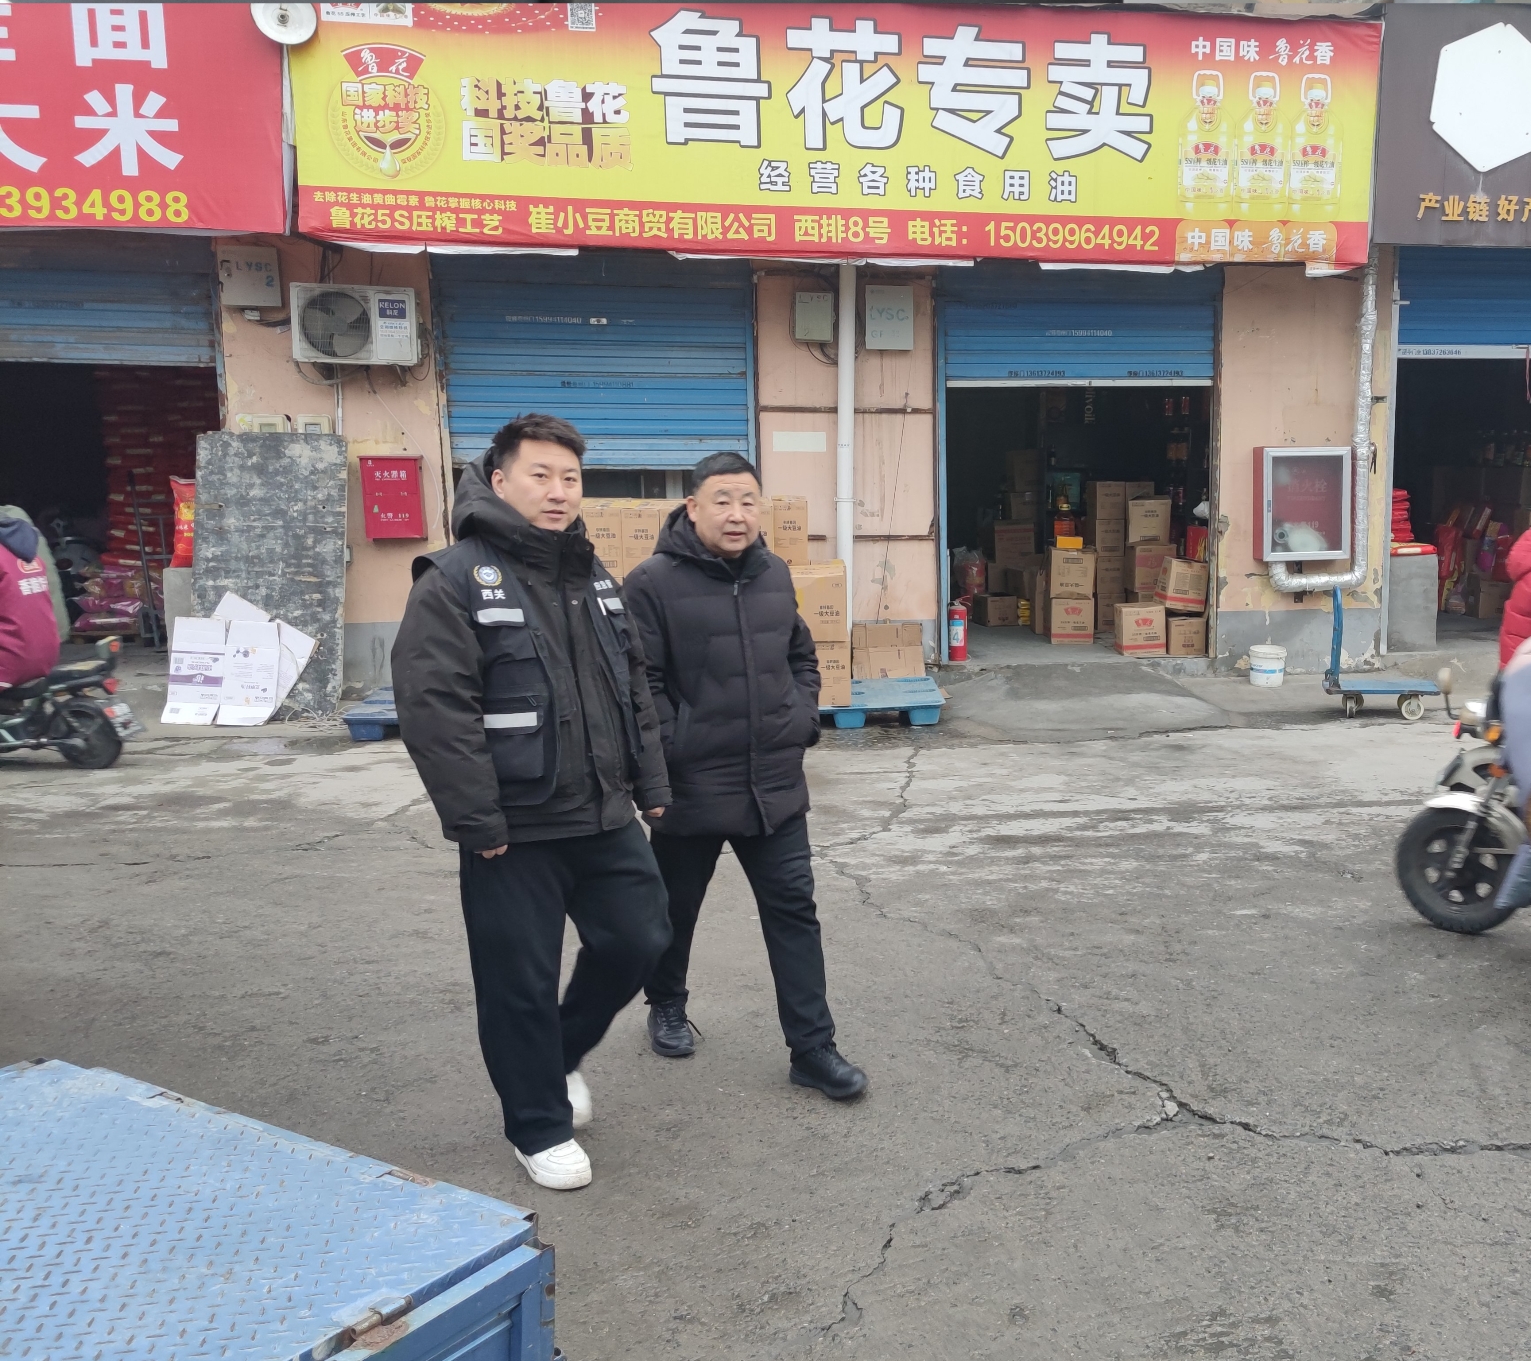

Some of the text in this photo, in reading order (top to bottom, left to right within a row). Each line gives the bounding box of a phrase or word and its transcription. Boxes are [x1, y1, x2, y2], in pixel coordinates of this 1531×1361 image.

[0, 4, 172, 68] 面
[1190, 35, 1335, 67] 中国味 鲁花香
[357, 46, 413, 76] 鲁花
[340, 80, 430, 112] 国家科技
[459, 78, 632, 125] 科技鲁花
[649, 10, 1154, 164] 鲁花专卖
[353, 107, 421, 137] 进步奖
[461, 123, 635, 171] 国奖品质
[757, 157, 1079, 204] 经营各种食用油
[0, 185, 190, 226] 3934988
[312, 190, 518, 212] 去除花生油黄曲霉素 鲁花掌握核心科技
[1416, 191, 1490, 226] 产业链
[328, 204, 505, 236] 鲁花5S压榨工艺
[526, 201, 777, 245] 崔小豆商贸有限公司
[793, 211, 892, 246] 西排8号
[1187, 226, 1328, 255] 中国味 鲁花香
[378, 300, 406, 310] KELON
[480, 588, 506, 600] 西关
